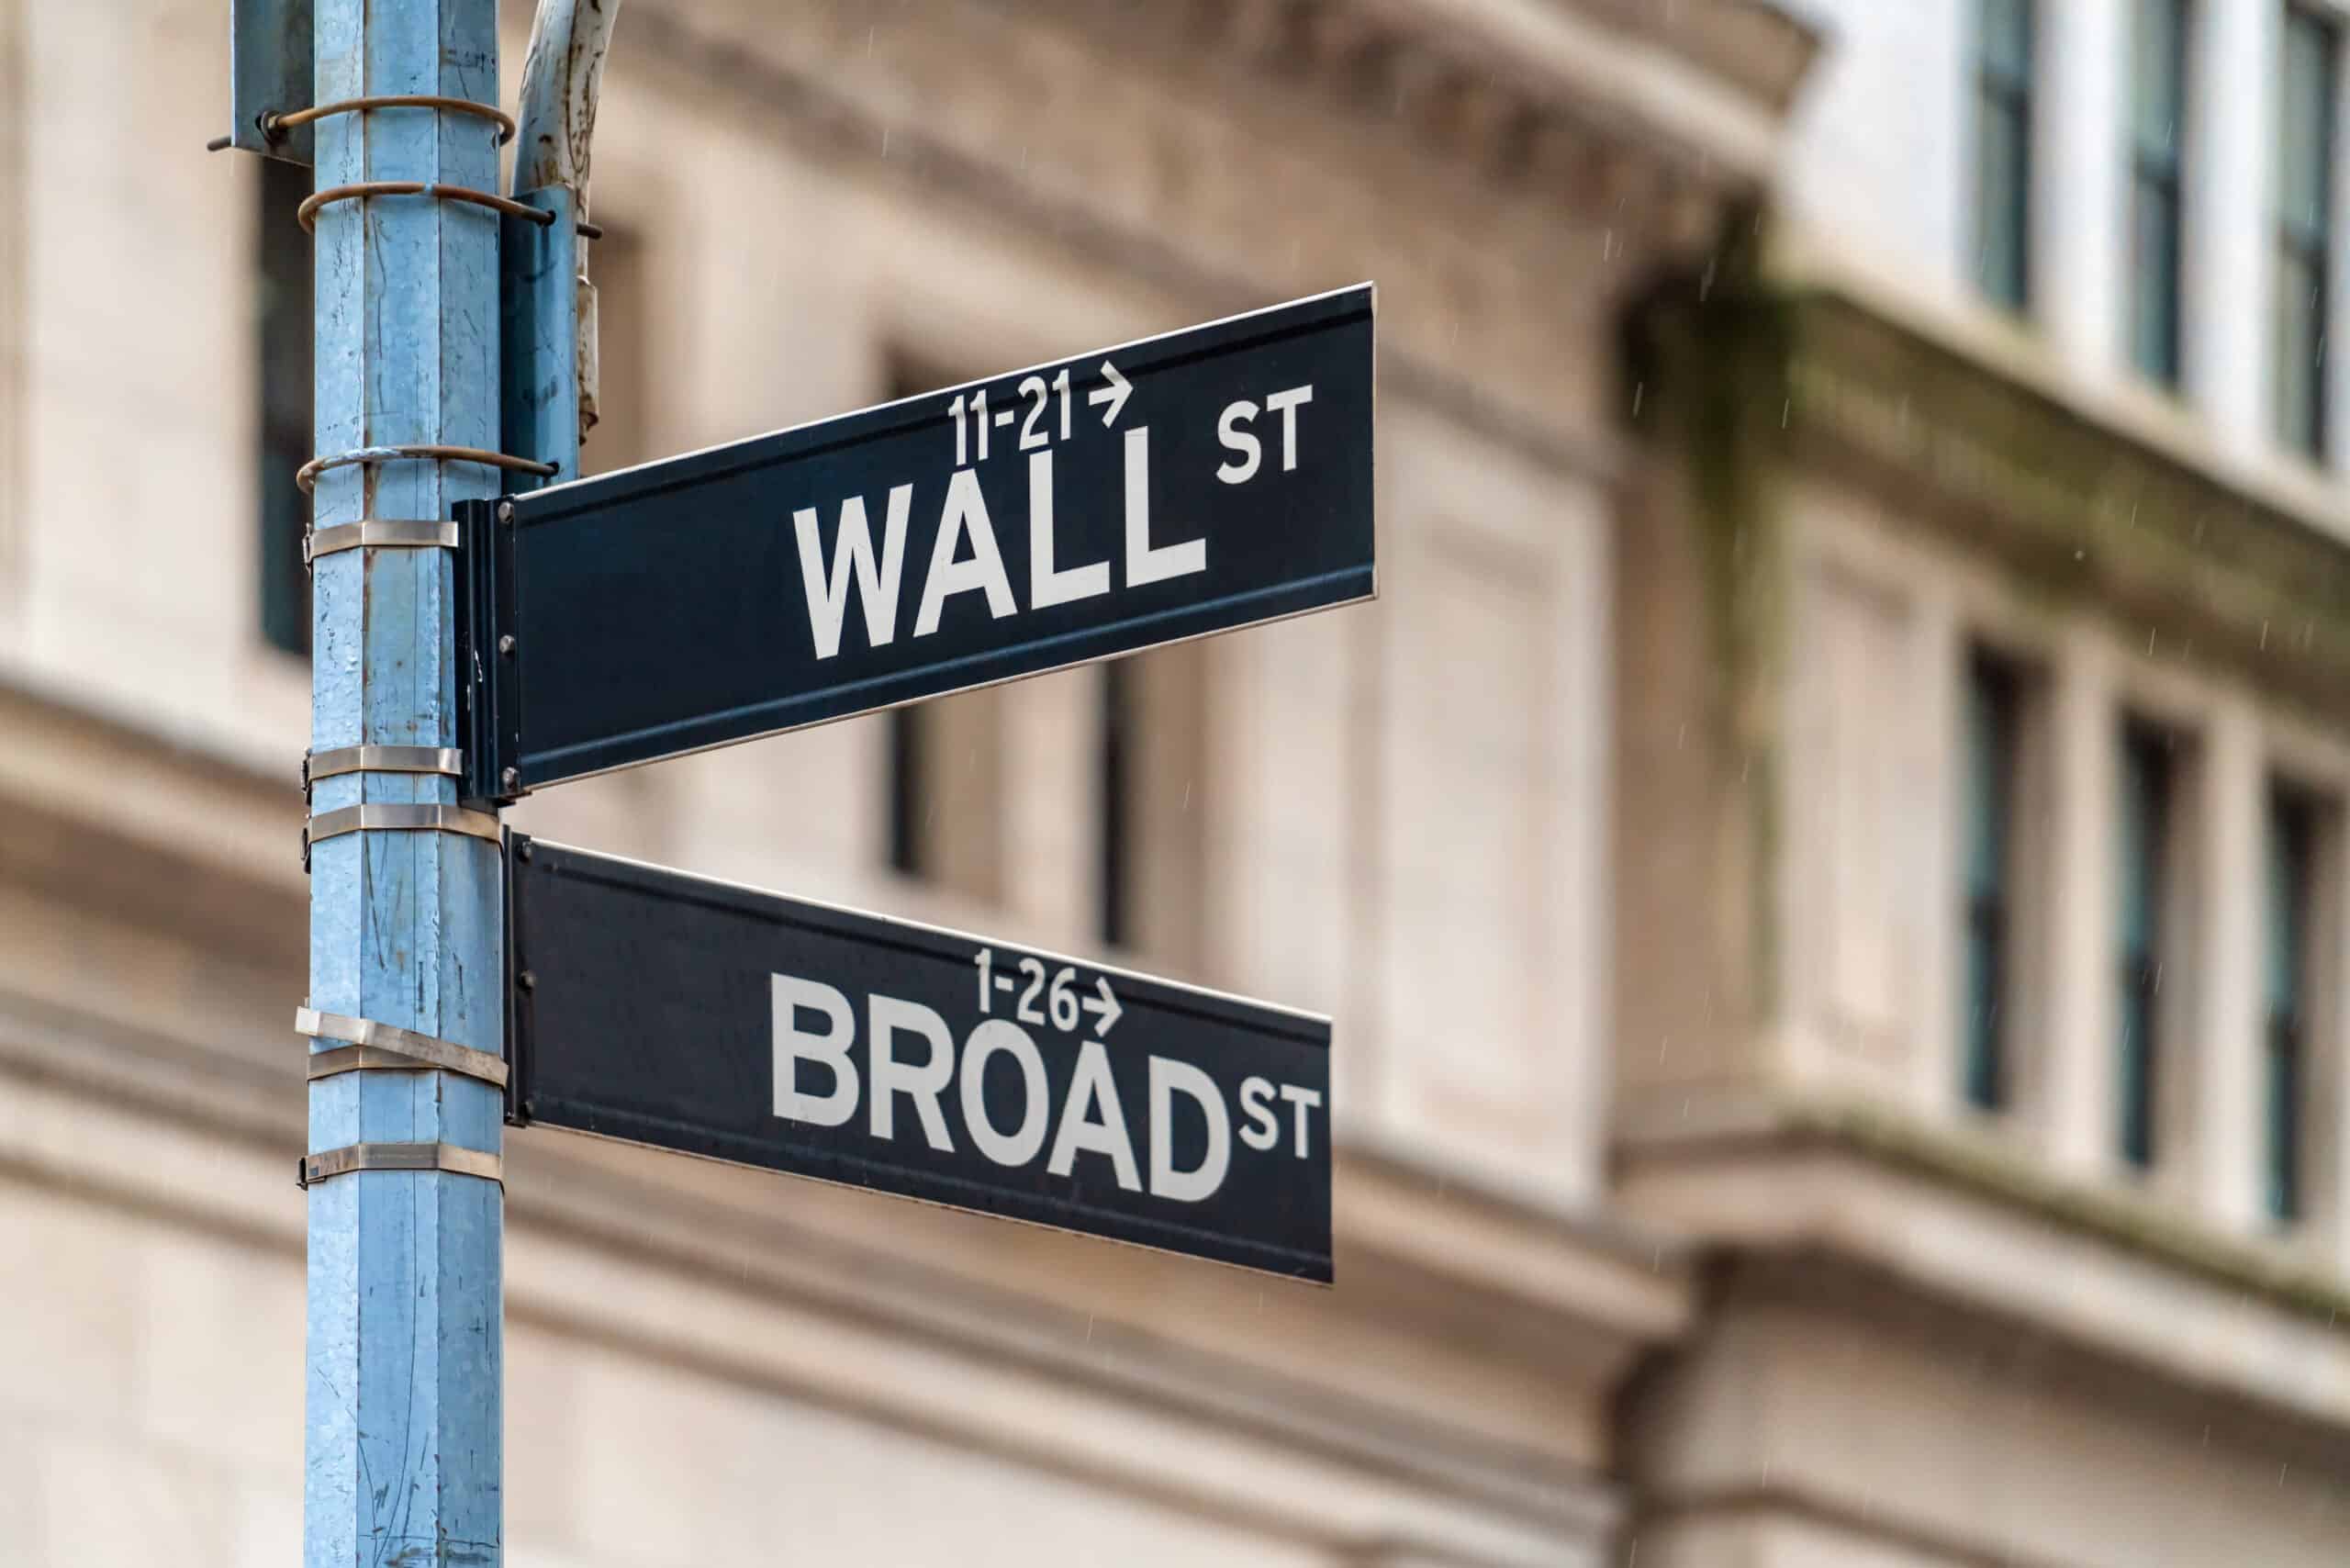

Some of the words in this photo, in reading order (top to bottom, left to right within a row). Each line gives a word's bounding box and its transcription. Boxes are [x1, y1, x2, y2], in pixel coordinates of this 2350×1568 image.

[947, 368, 1071, 466] 11-21
[792, 425, 1206, 660] WALL
[1216, 384, 1313, 485] ST
[975, 948, 1079, 1032] 1-26
[771, 972, 1230, 1202] BROAD
[1238, 1077, 1321, 1159] ST
